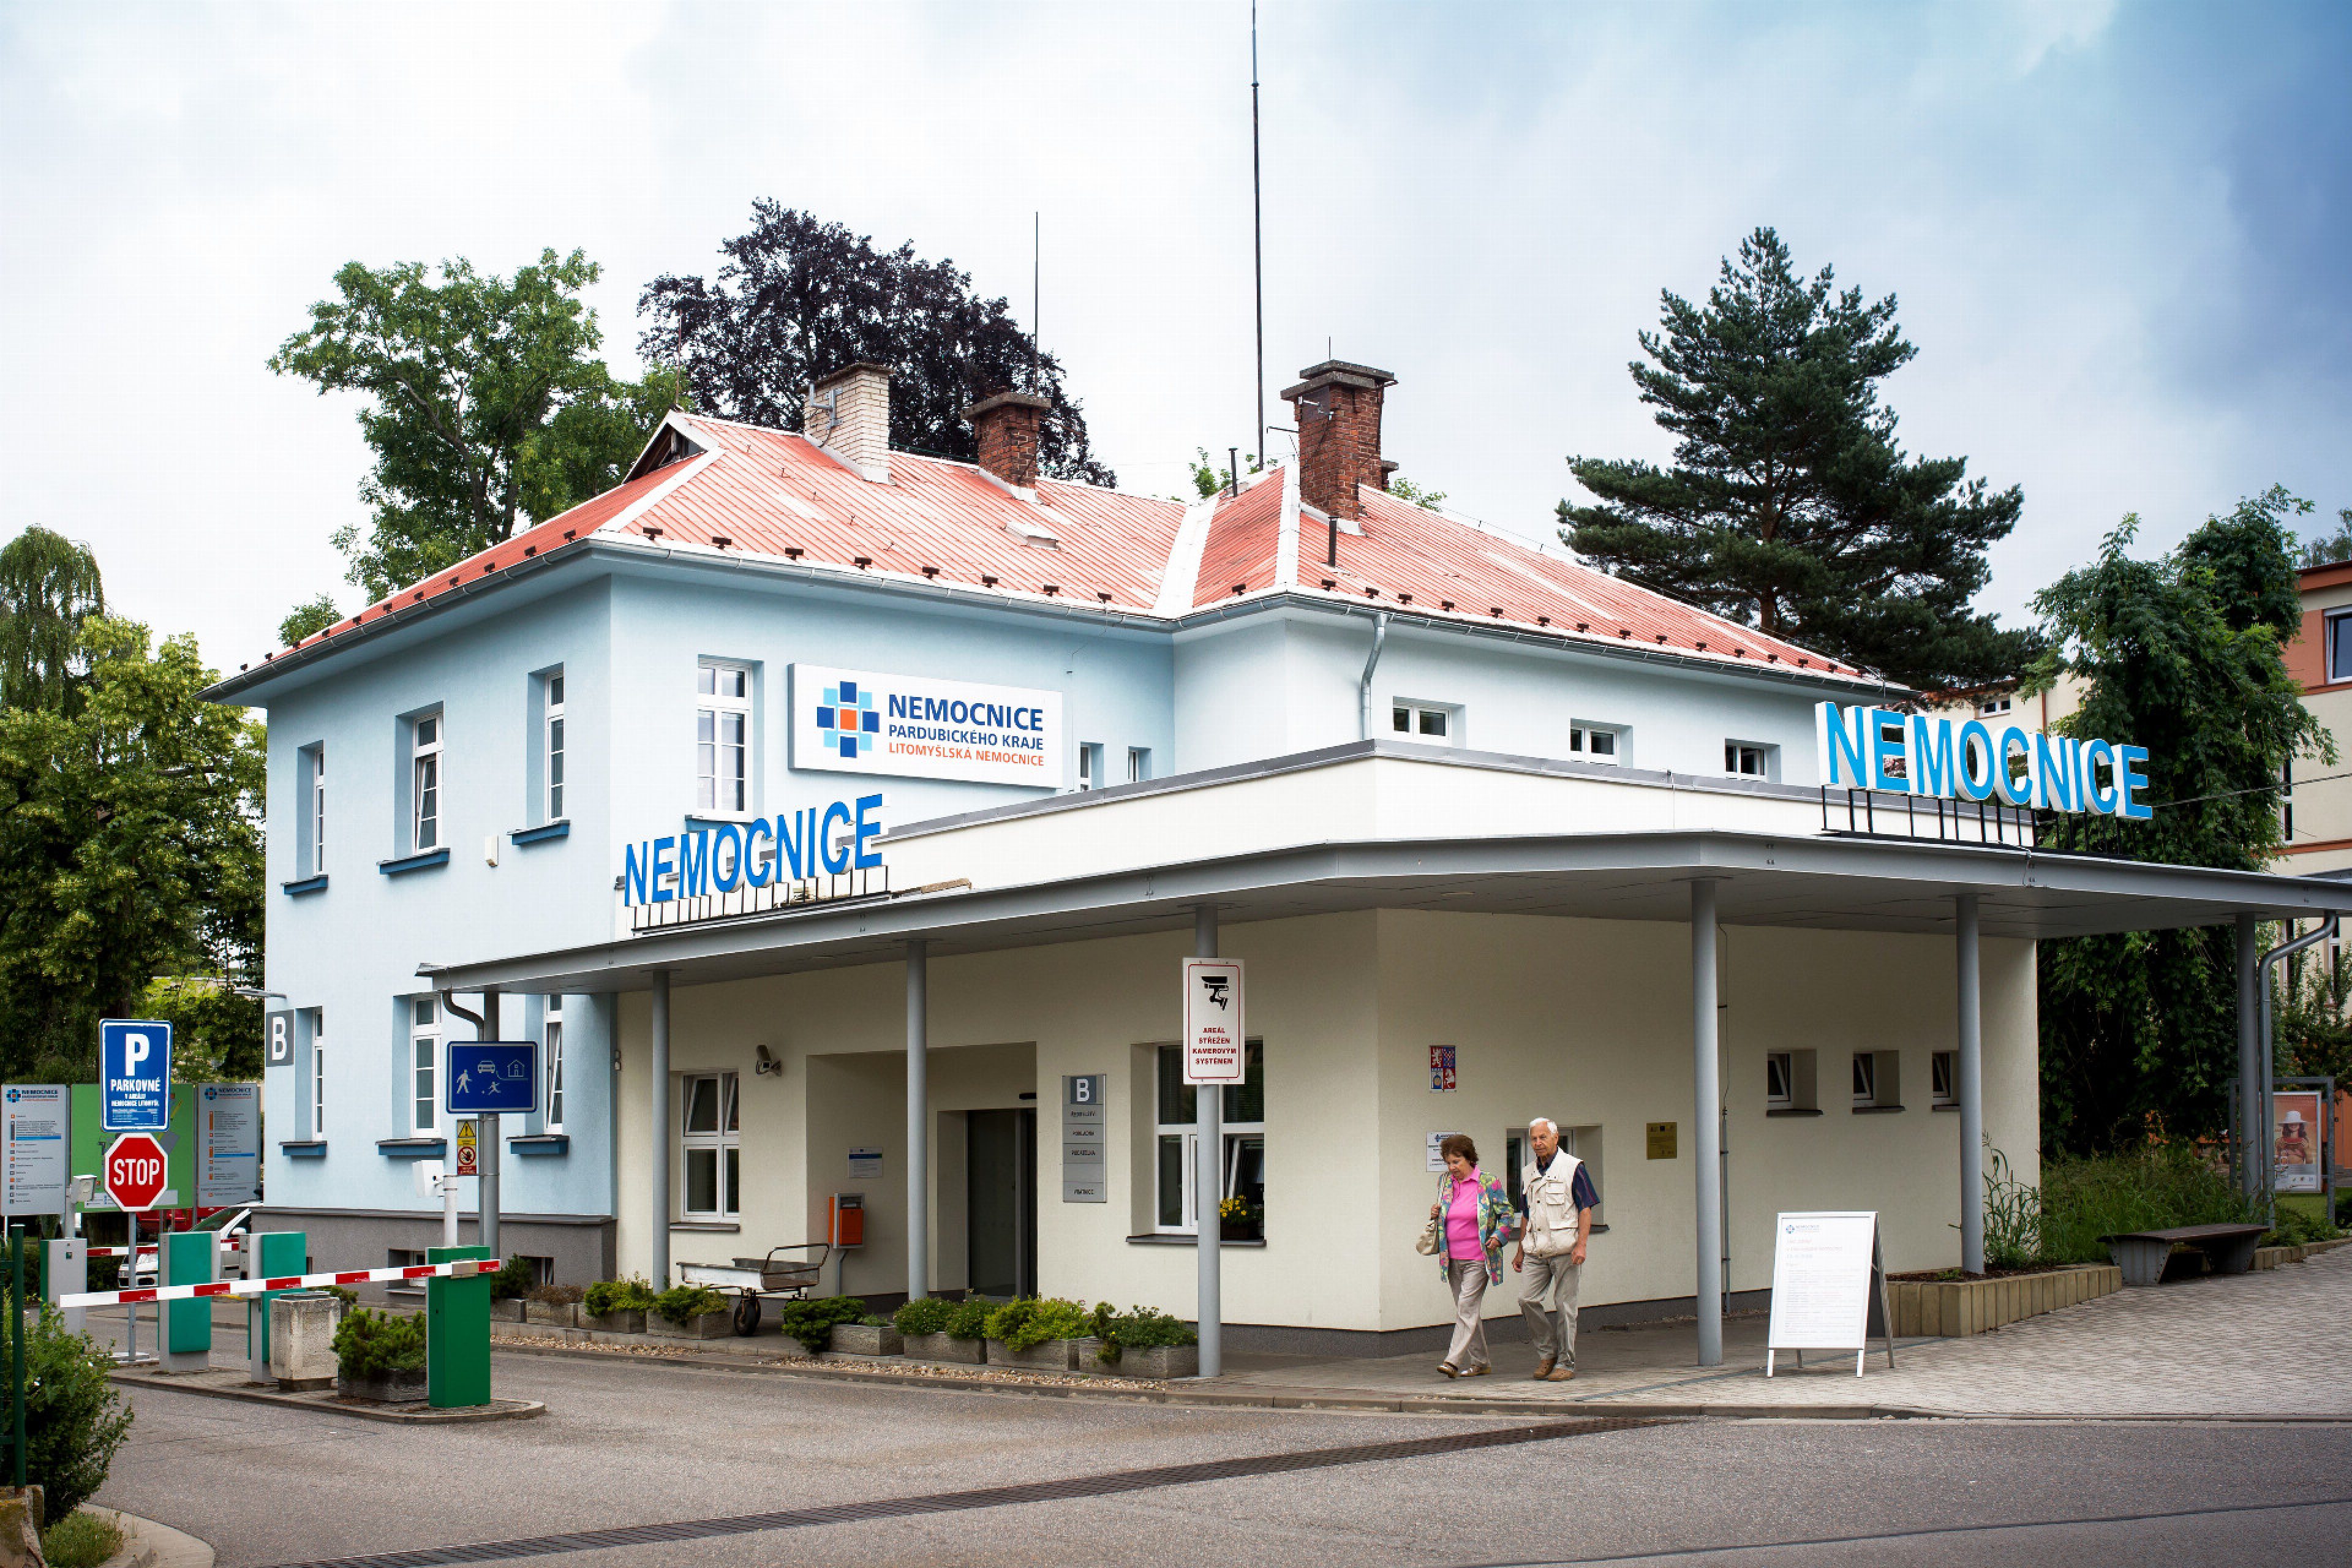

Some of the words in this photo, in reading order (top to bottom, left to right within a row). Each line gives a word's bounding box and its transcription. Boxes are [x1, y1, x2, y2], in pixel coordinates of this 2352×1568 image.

[889, 693, 1044, 732] NEMOCNICE
[889, 724, 997, 747] PARDUBICKÉHO
[1002, 734, 1044, 751] KRAJE
[889, 742, 973, 760] LITOMYŠLSKÁ
[976, 750, 1044, 767] NEMOCNICE
[1817, 701, 2152, 820] NEMOCNICE
[624, 793, 887, 907] NEMOCNICE
[125, 1033, 150, 1076] P
[271, 1016, 287, 1061] B
[110, 1077, 161, 1092] PARKOVNÉ
[1076, 1078, 1090, 1102] B
[113, 1158, 160, 1186] STOP
